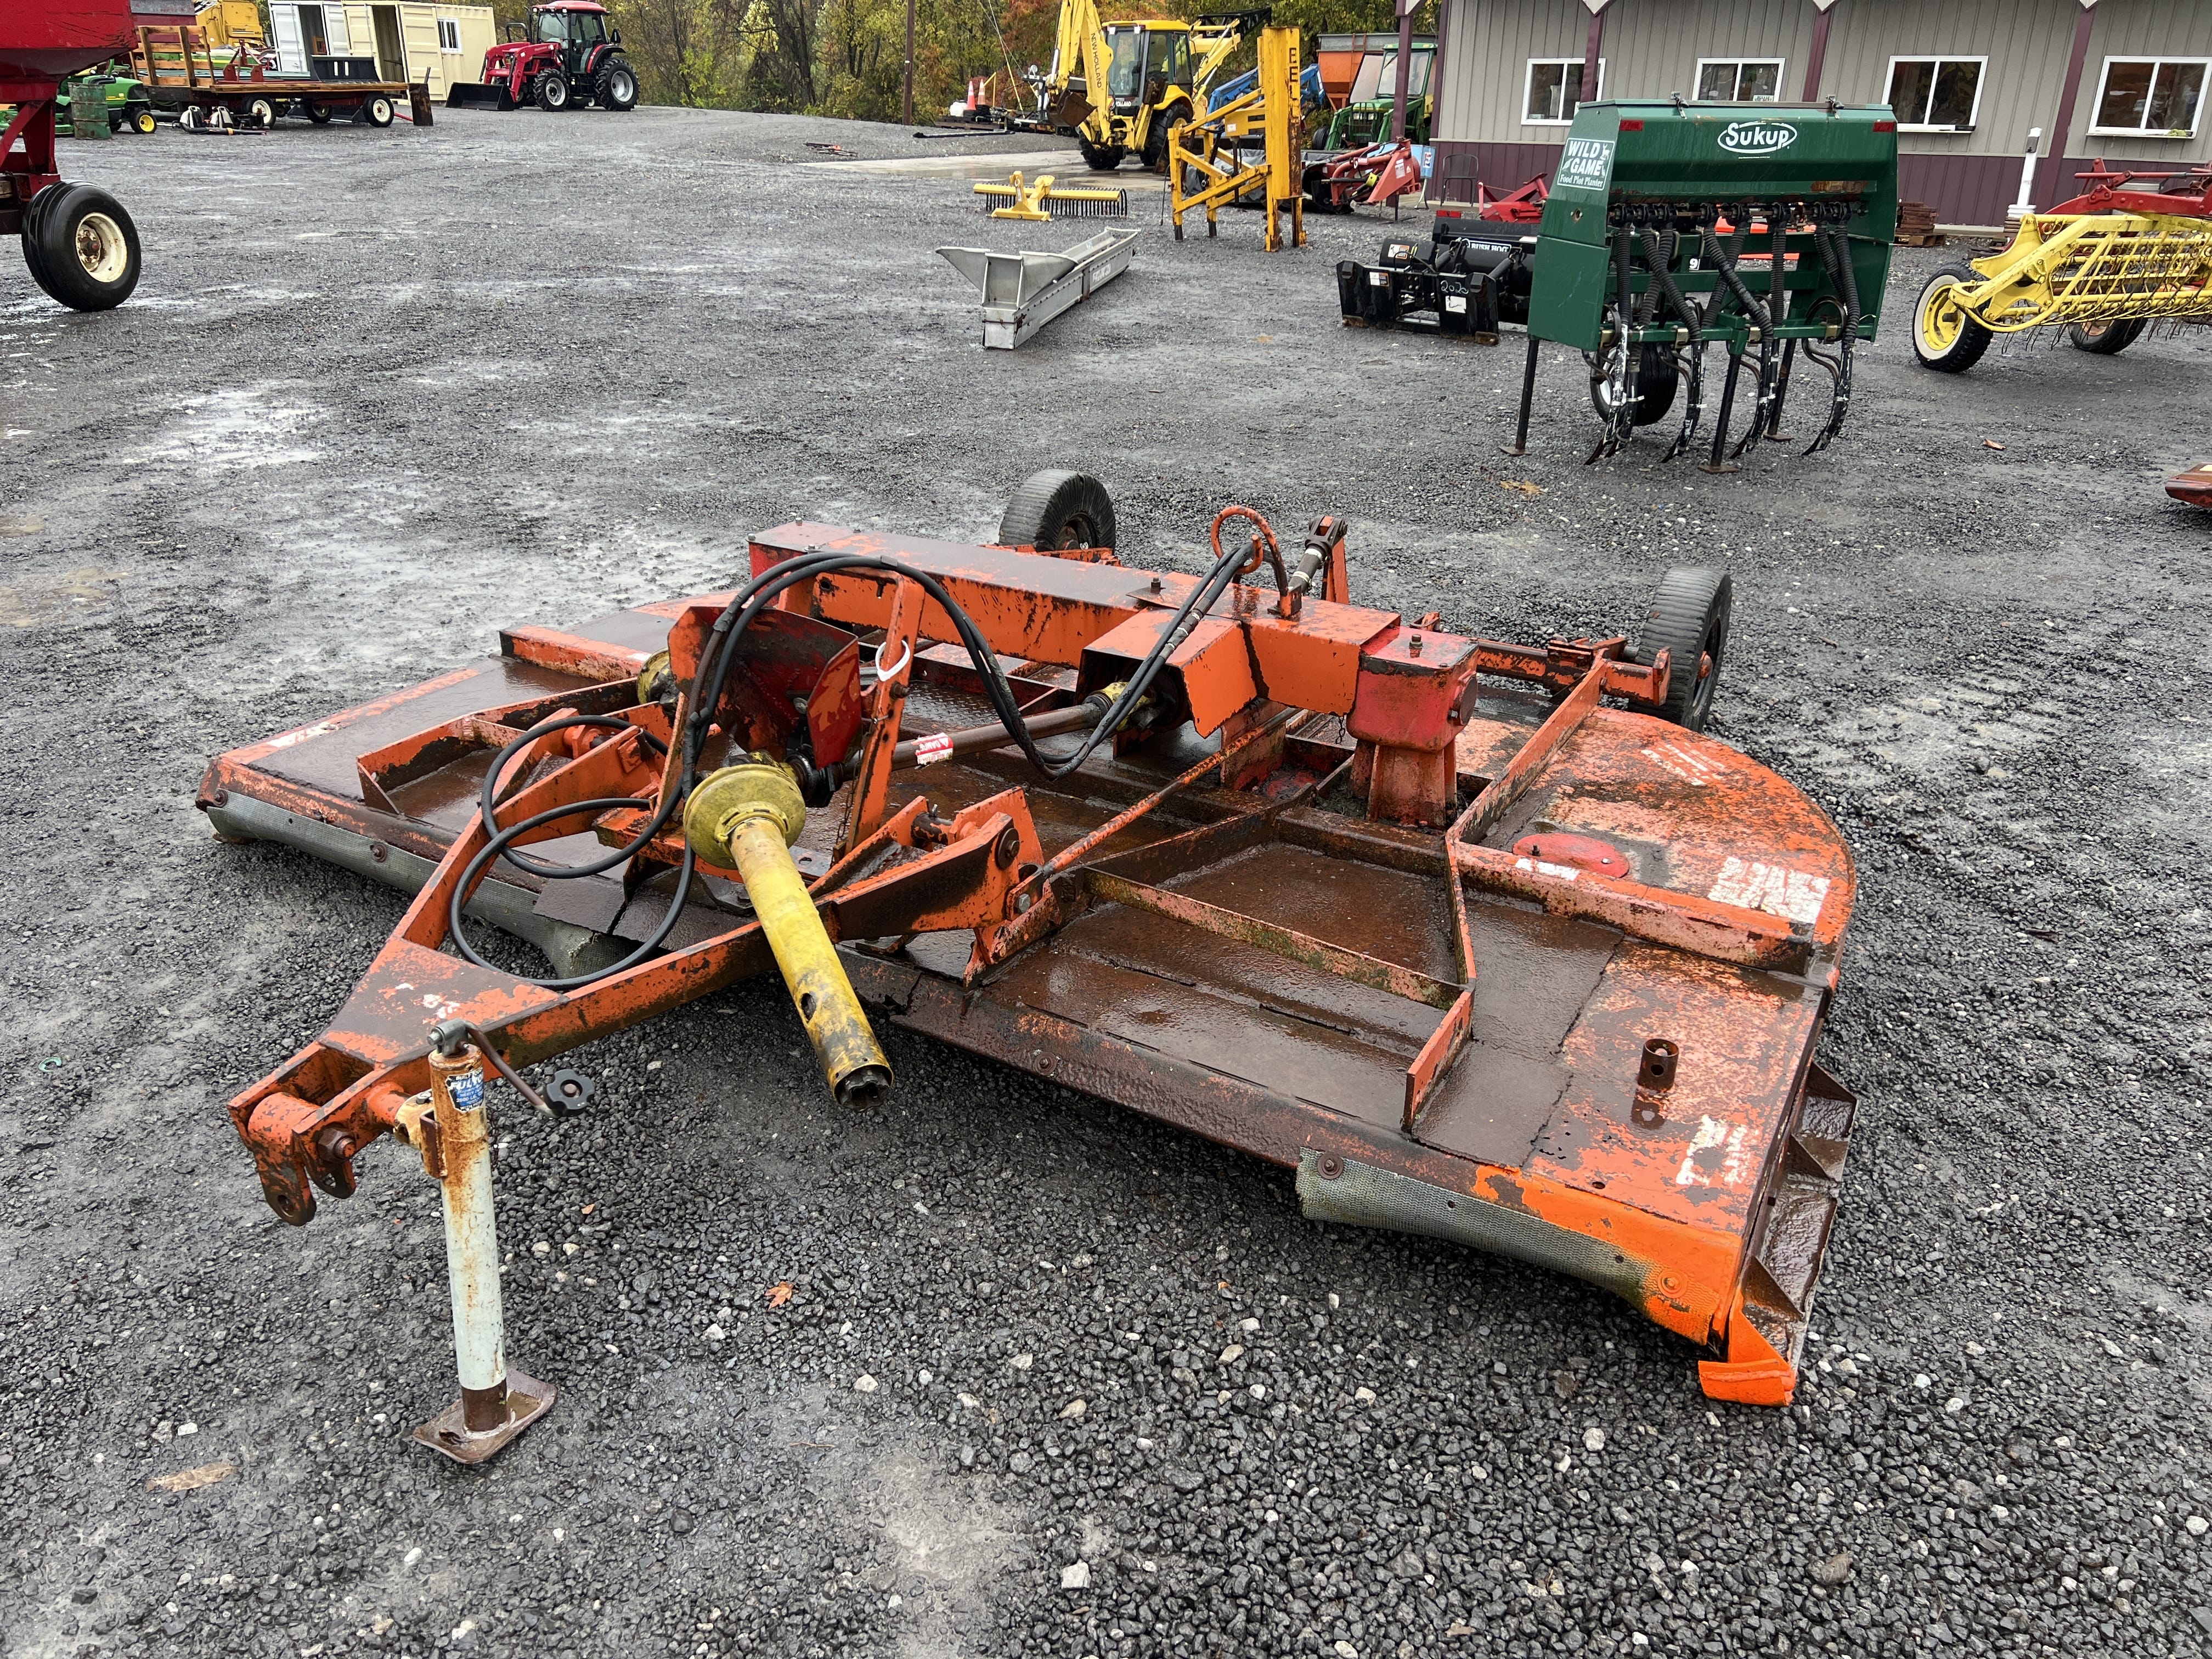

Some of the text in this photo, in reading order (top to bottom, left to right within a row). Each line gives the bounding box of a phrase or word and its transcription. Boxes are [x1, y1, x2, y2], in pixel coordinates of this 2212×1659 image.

[1093, 52, 1102, 88] HOLLAND
[1725, 122, 1789, 150] Sukup
[1567, 140, 1601, 158] WILD
[1570, 157, 1604, 176] GAME
[1560, 174, 1603, 187] Food Plot Planter
[447, 1072, 483, 1091] FULTO
